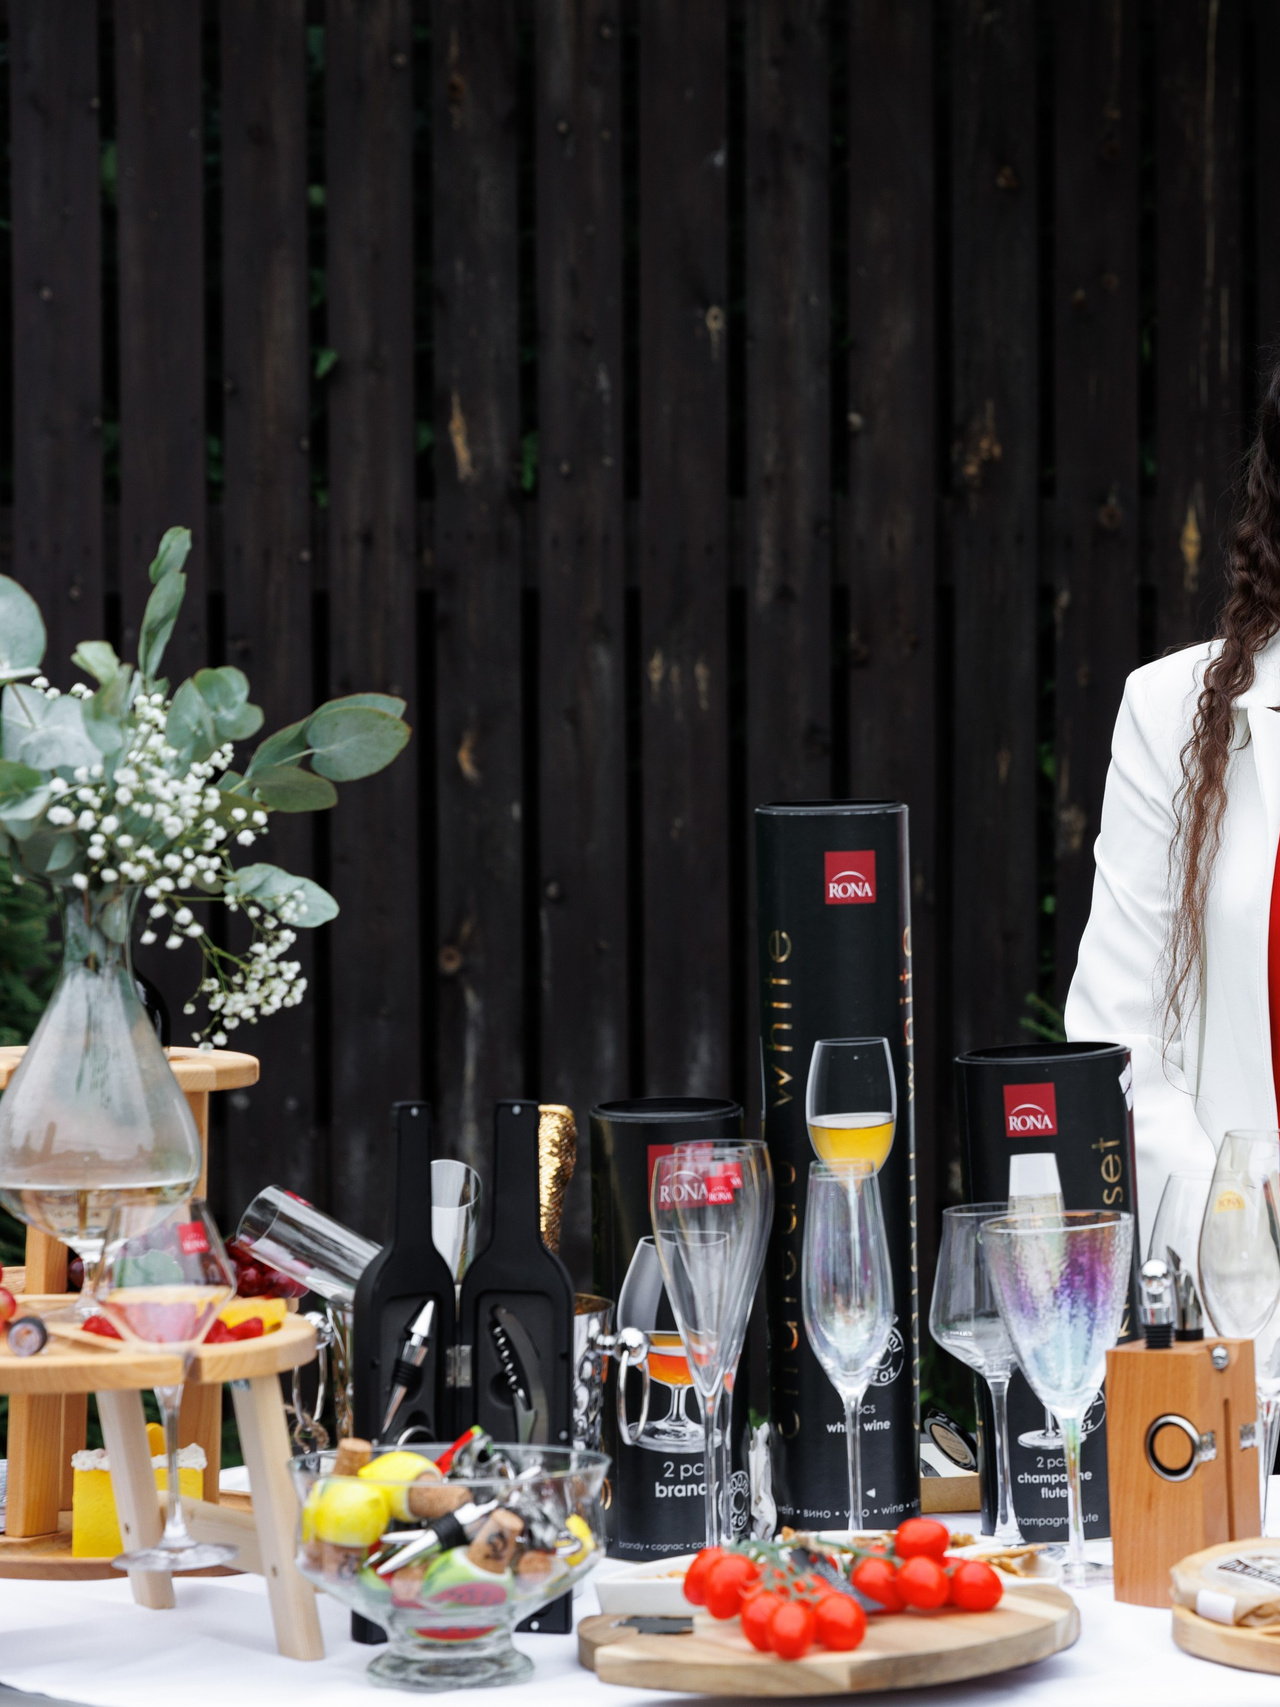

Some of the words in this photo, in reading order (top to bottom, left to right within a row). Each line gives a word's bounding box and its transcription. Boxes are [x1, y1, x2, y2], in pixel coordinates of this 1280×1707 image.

[828, 881, 873, 899] RONA
[1008, 1113, 1053, 1132] RONA
[1091, 1137, 1123, 1205] set
[659, 1182, 709, 1204] RONA
[863, 1419, 891, 1431] wine
[663, 1461, 674, 1478] 2
[1036, 1456, 1045, 1468] 2
[881, 1503, 905, 1515] wine
[650, 1542, 684, 1552] cognac
